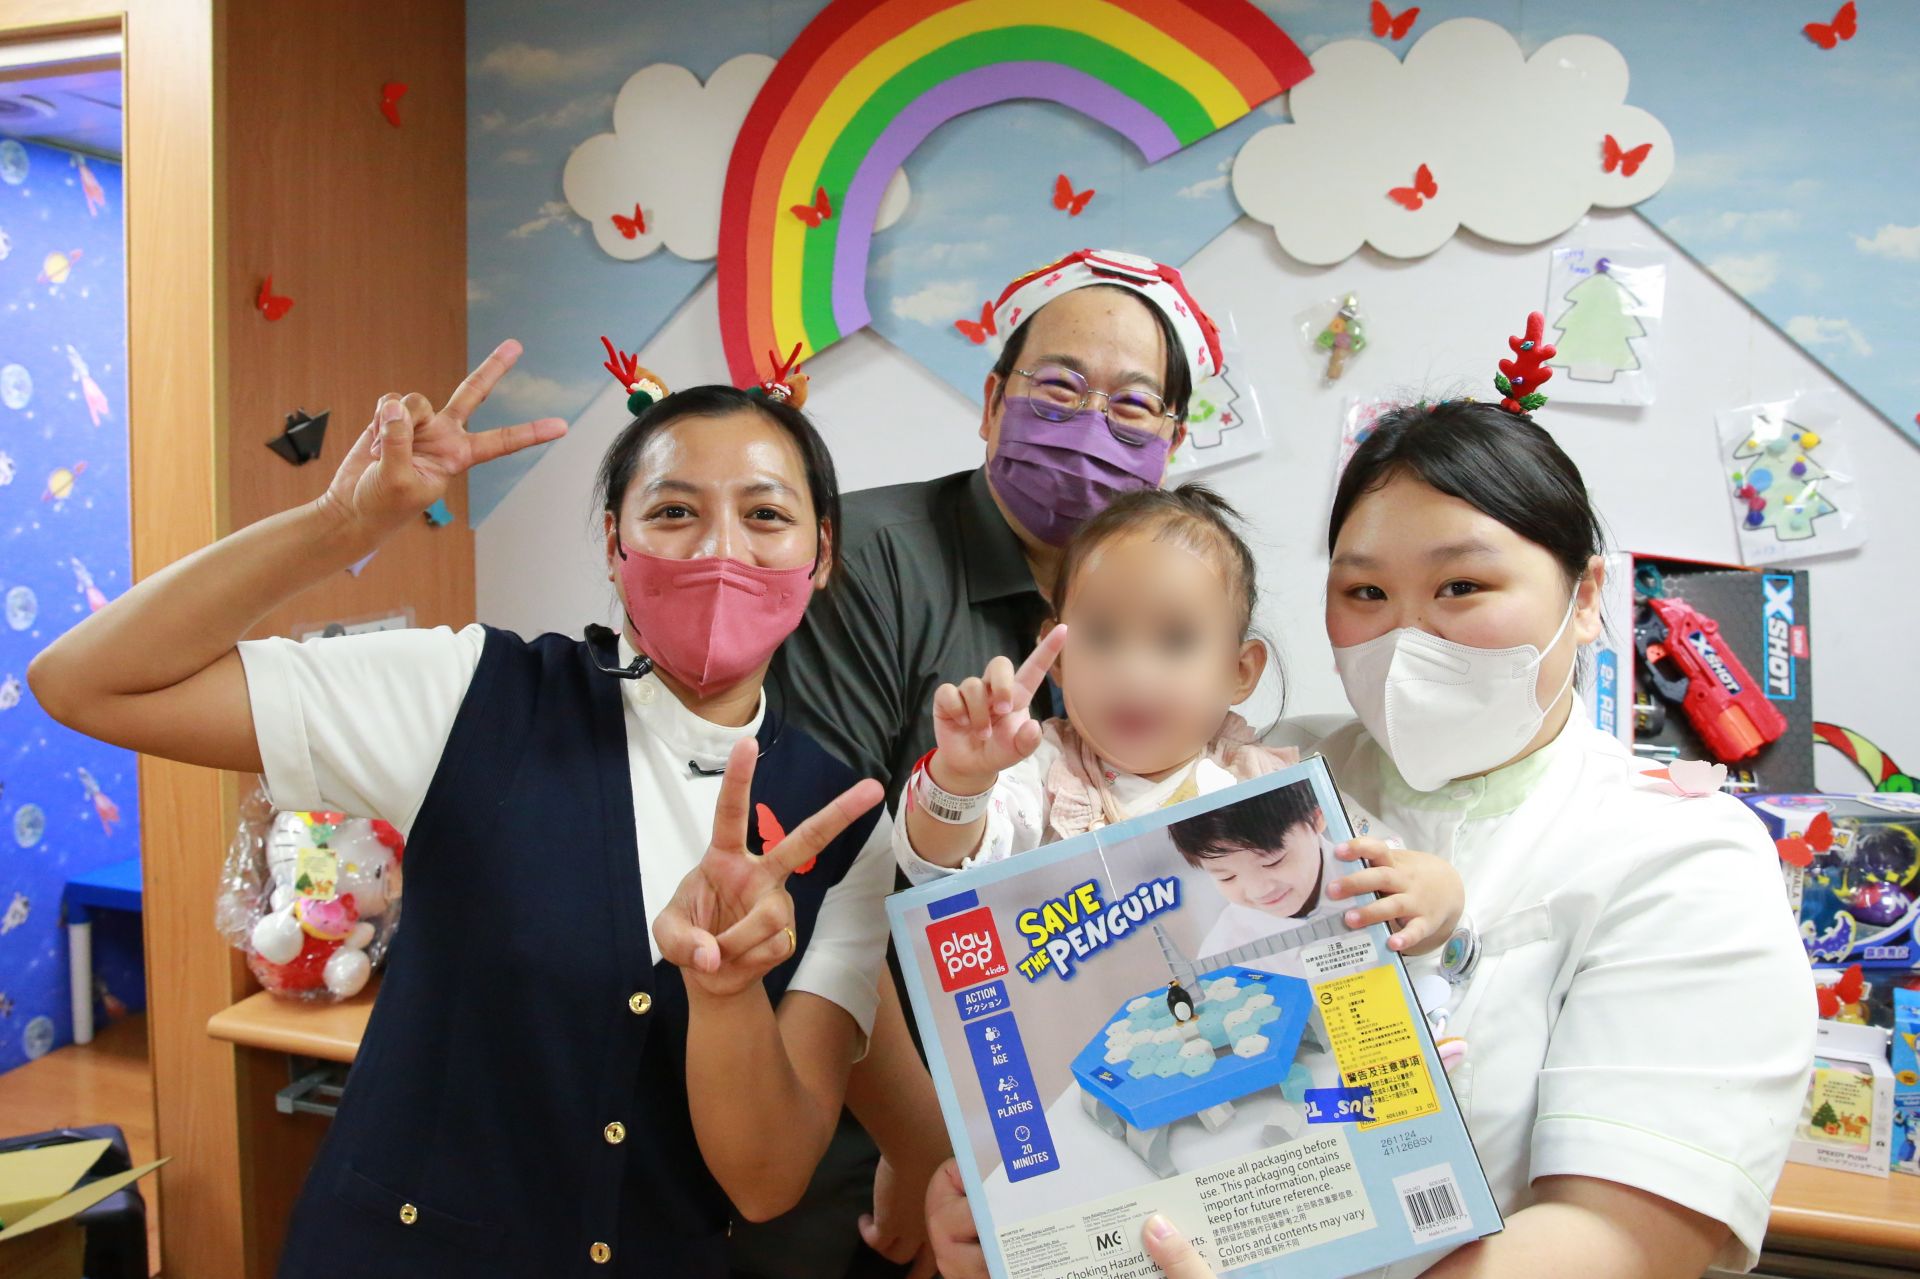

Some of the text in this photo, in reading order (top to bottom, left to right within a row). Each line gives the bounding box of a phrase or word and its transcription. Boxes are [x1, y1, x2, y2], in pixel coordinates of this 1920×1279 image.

[1018, 882, 1101, 948] SAVE
[940, 929, 993, 964] play
[1327, 941, 1343, 952] 注意
[947, 947, 993, 980] pop
[985, 964, 1006, 976] 4kids
[1019, 948, 1051, 979] THE
[965, 986, 997, 1005] ACTION
[965, 998, 1002, 1015] アクション
[990, 1043, 1003, 1054] 5+
[992, 1053, 1009, 1066] AGE
[1346, 1055, 1421, 1083] 警告及注意事項
[1004, 1092, 1019, 1104] 2-4
[997, 1100, 1034, 1119] PLAYERS
[1021, 1143, 1033, 1155] 20
[1381, 1130, 1416, 1148] 261124
[1012, 1151, 1049, 1171] MINUTES
[1195, 1137, 1338, 1187] Remove all packaging before
[1200, 1151, 1341, 1200] use. This packaging contains
[1203, 1161, 1352, 1213] important information, please
[1207, 1181, 1334, 1225] keep for future reference.
[1218, 1241, 1252, 1259] Colors
[1253, 1235, 1273, 1249] and
[1274, 1222, 1318, 1244] contents
[1319, 1214, 1342, 1231] may
[1343, 1207, 1367, 1225] vary
[1066, 1263, 1108, 1279] Choking
[1110, 1251, 1145, 1271] Hazard
[1189, 1236, 1208, 1248] rts.
[1137, 1262, 1164, 1276] und
